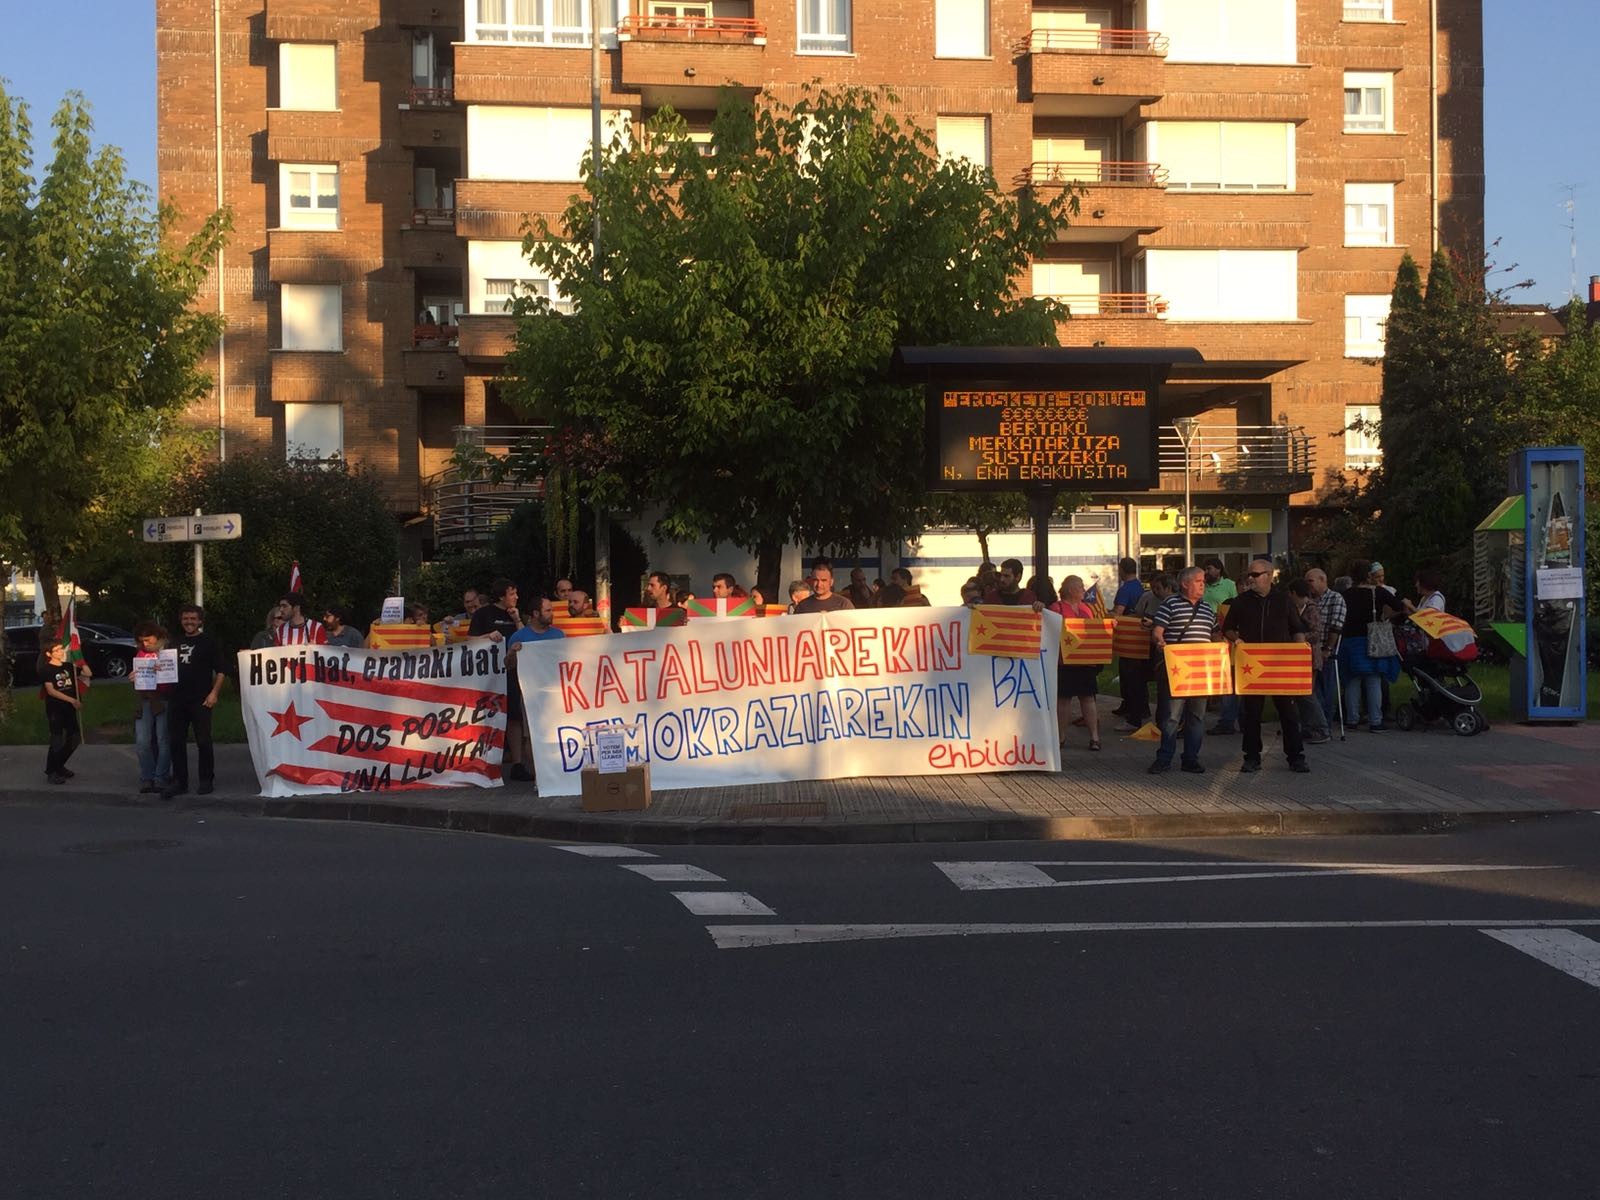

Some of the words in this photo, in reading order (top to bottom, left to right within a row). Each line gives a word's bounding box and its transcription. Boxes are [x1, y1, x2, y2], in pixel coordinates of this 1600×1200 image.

[1000, 422, 1088, 436] BERTAKO
[969, 436, 1120, 450] MERKATARITZA
[981, 451, 1108, 465] SUSTATZEKO
[976, 466, 1009, 480] ENA
[1020, 465, 1127, 479] ERAKUTSITA
[250, 651, 307, 685] Herri
[314, 651, 356, 685] bat,
[363, 645, 453, 681] erabaki
[461, 644, 506, 677] bat.
[559, 621, 961, 713] KATALUNIAREKIN
[336, 724, 391, 755] DOS
[401, 693, 506, 746] POBLES
[341, 763, 391, 792] UNA
